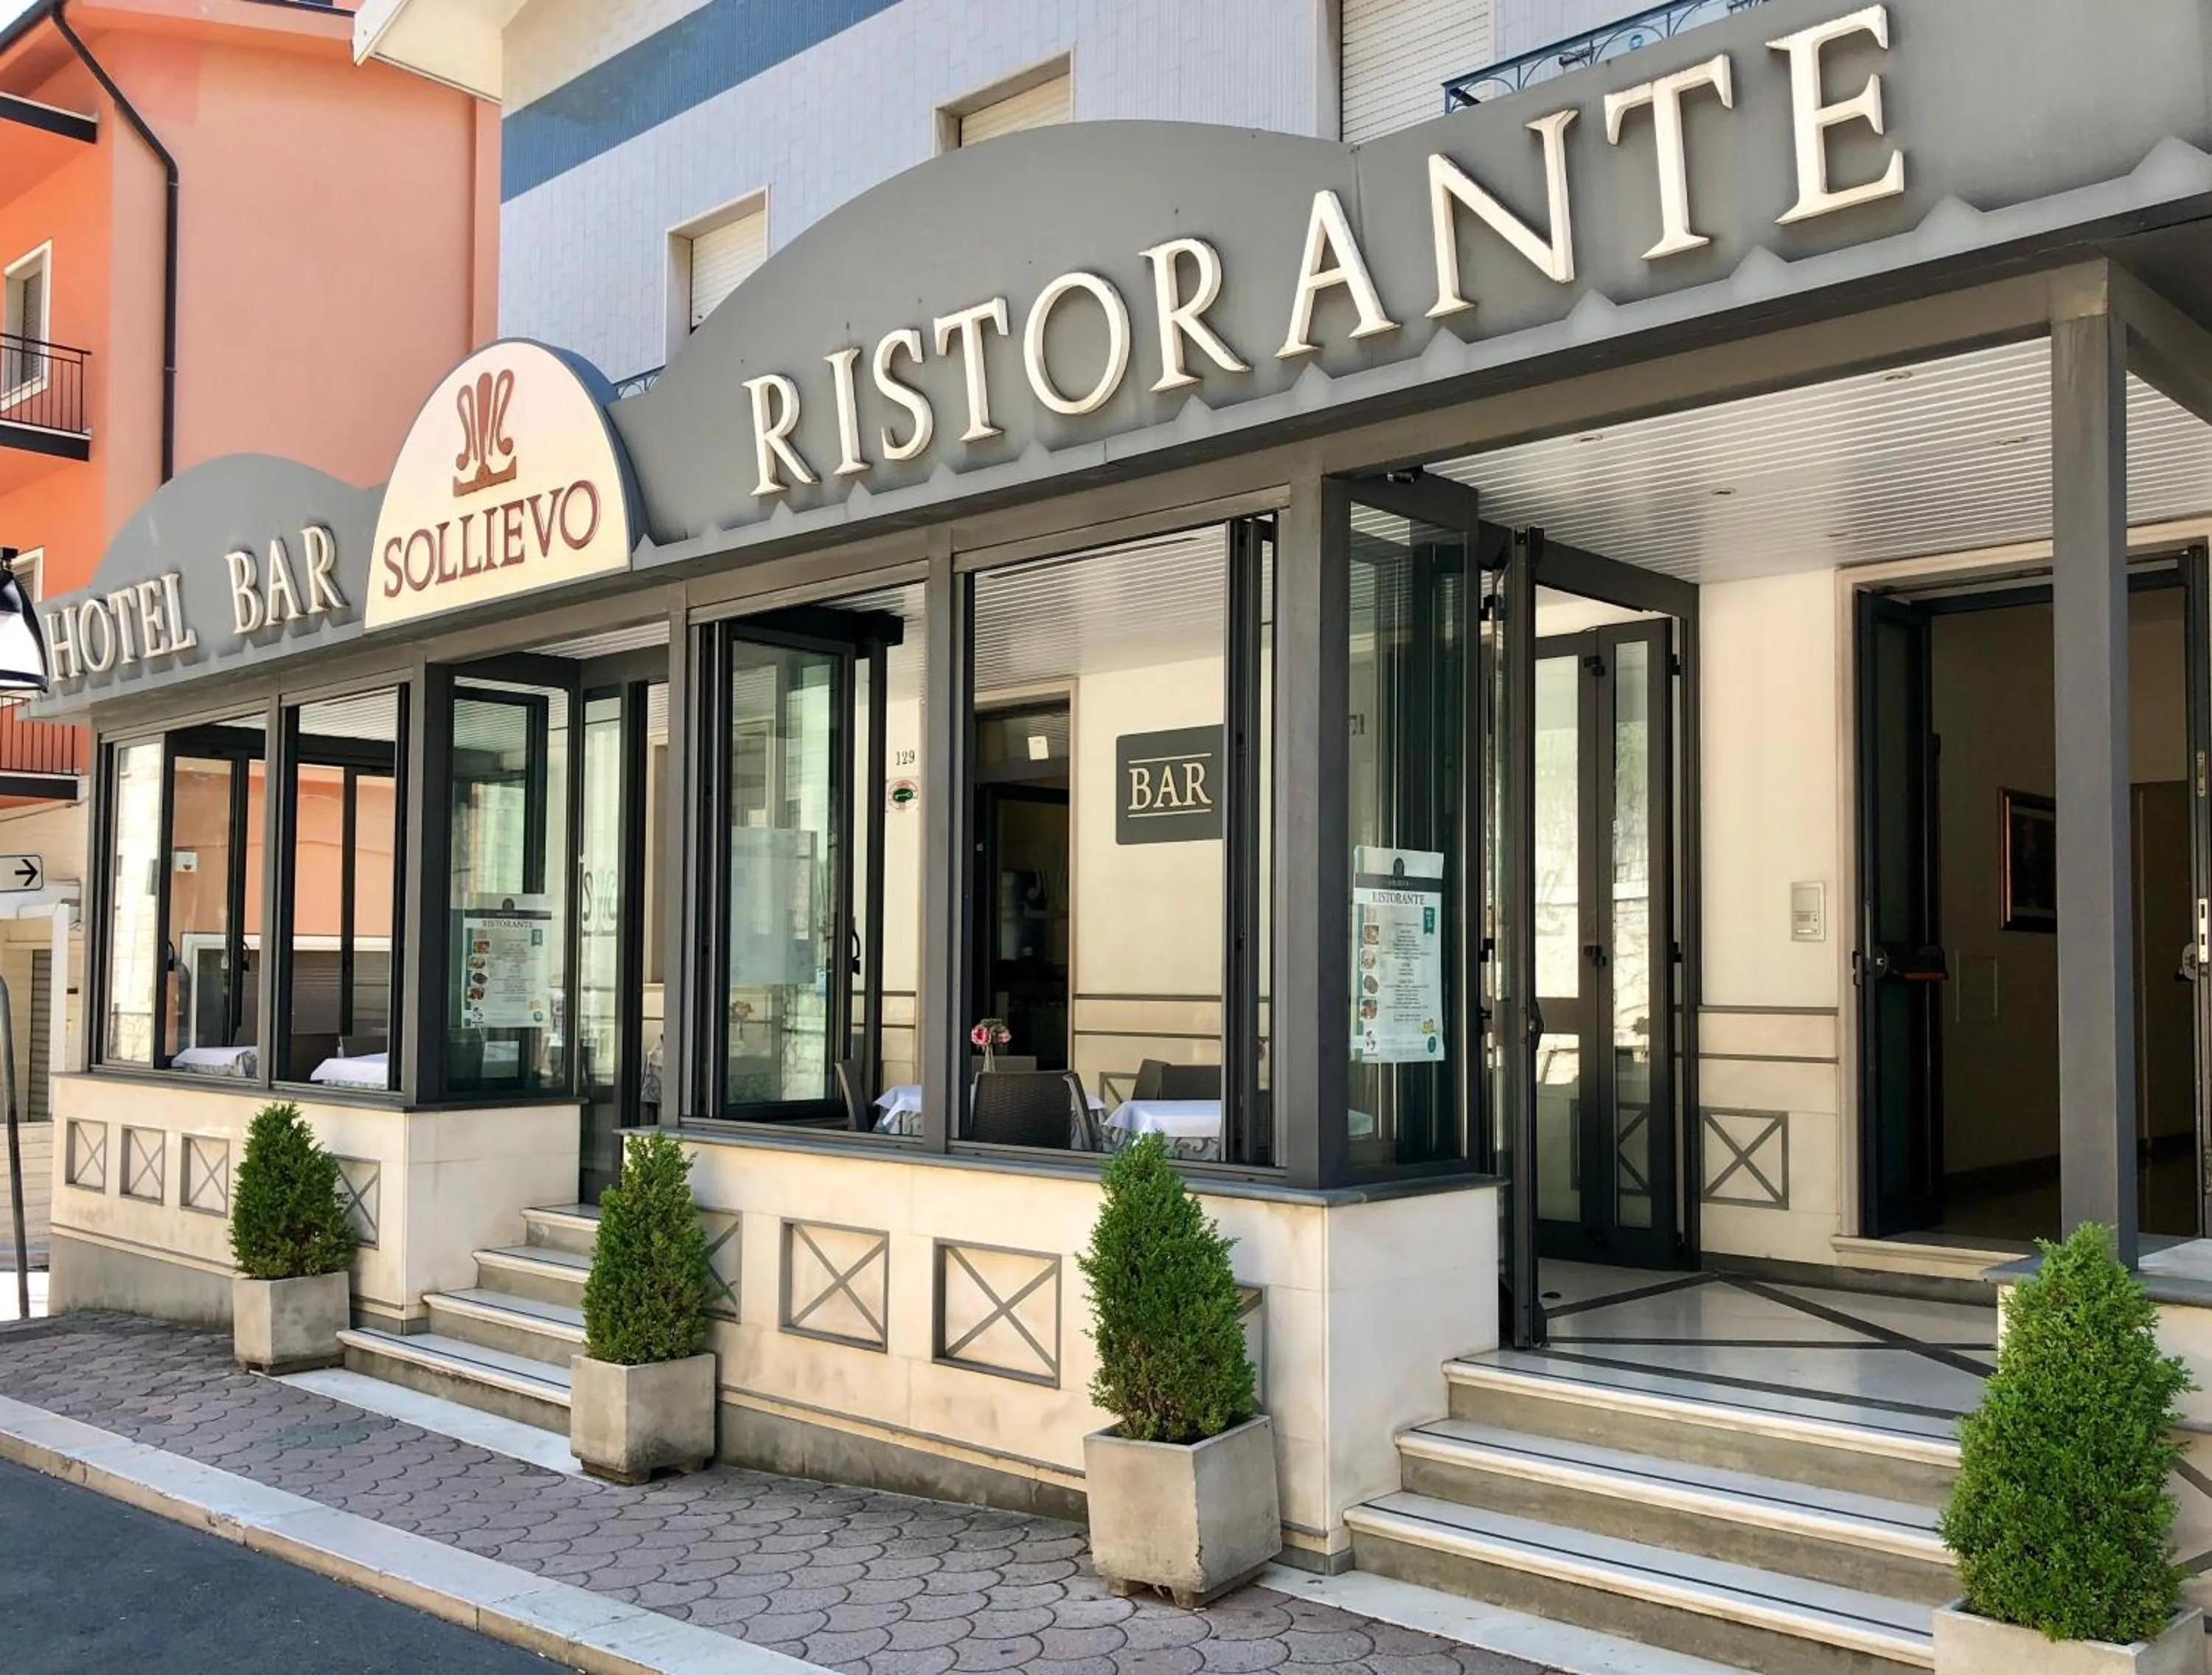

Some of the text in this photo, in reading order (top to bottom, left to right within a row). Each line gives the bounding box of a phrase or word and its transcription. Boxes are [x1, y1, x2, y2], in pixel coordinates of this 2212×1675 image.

[742, 4, 1905, 496] RISTORANTE
[383, 480, 601, 599] SOLLIEVO
[46, 525, 352, 683] HOTEL BAR
[896, 750, 915, 766] 129
[1128, 762, 1211, 810] BAR
